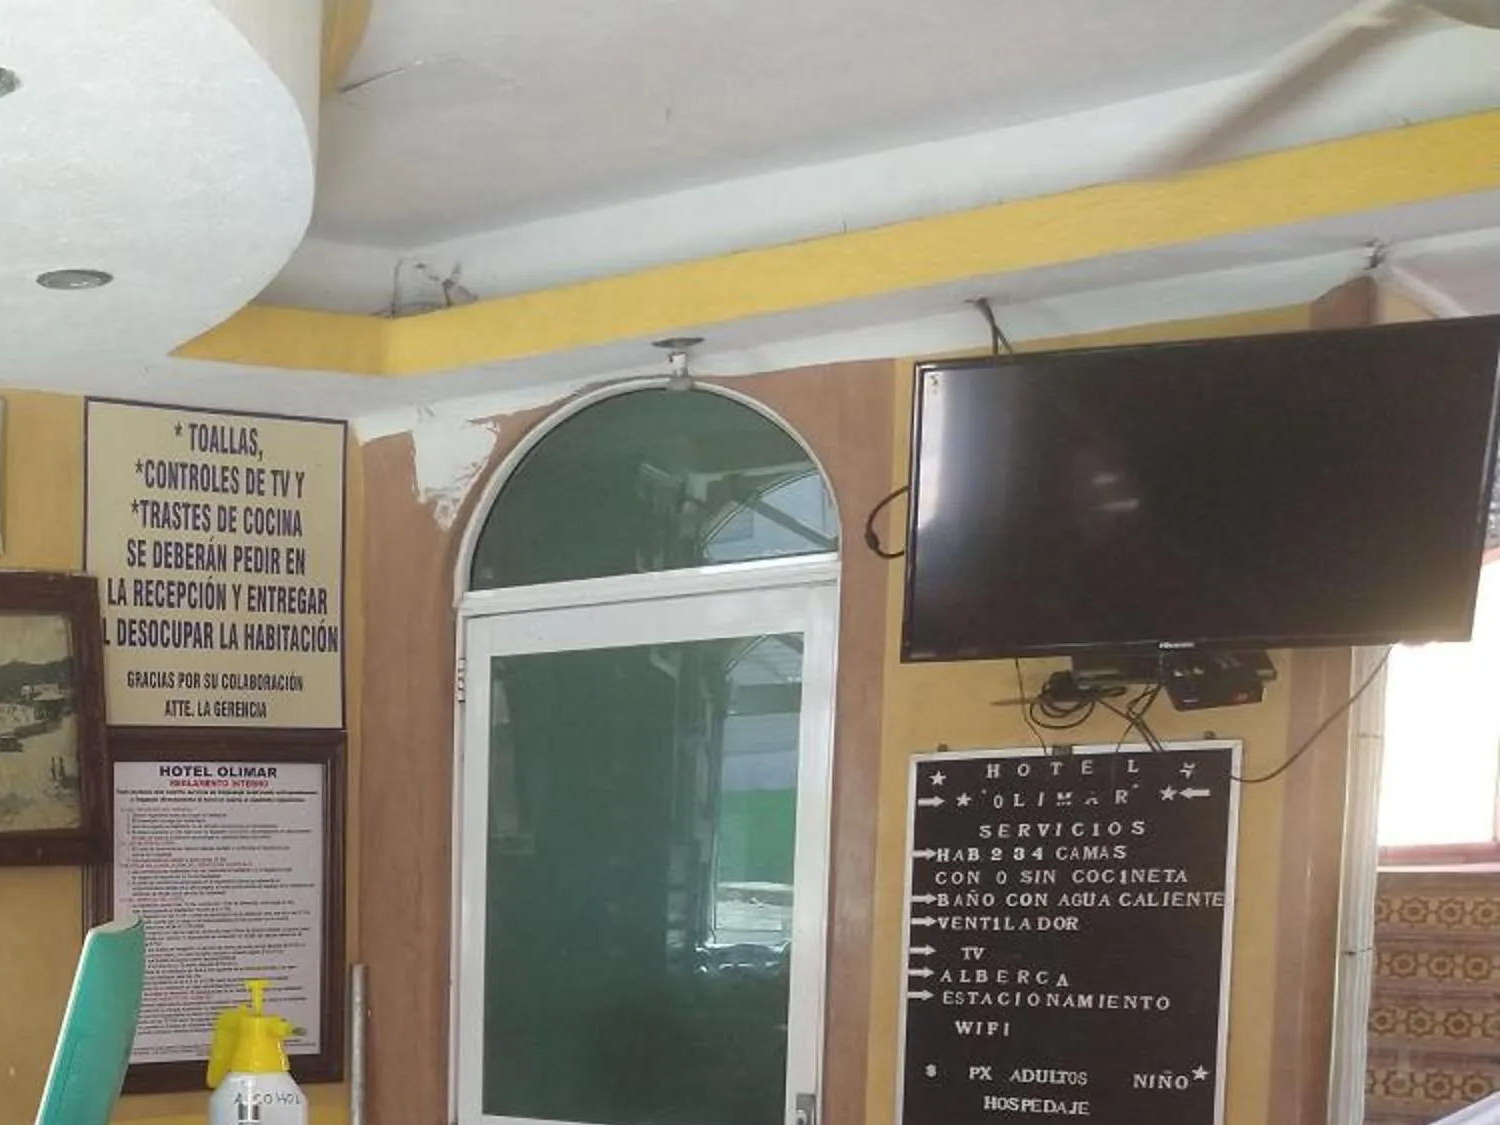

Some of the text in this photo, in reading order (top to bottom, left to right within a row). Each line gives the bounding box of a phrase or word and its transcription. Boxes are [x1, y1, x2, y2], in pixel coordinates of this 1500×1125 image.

[189, 423, 263, 460] TOALLAS,
[145, 460, 305, 499] CONTROLES DE TV Y
[140, 500, 303, 537] TRASTES DE COCINA
[127, 536, 306, 575] SE DEBERÁN PEDIR EN
[107, 576, 328, 615] LA RECEPCIÓN Y ENTREGAR
[117, 618, 339, 653] DESOCUPAR LA HABITACIÓN
[127, 670, 303, 692] GRACIAS POR SU COLABORACIÓN
[197, 700, 267, 719] LA GERENCIA
[159, 765, 277, 779] HOTEL OLIMAR
[986, 759, 1140, 780] HOTEL
[979, 821, 1146, 839] SERVICIOS
[936, 847, 980, 863] HAB
[1055, 846, 1127, 861] CAMAS
[936, 869, 1188, 885] CON SIN COCINETA
[937, 890, 1225, 908] BAÑO CON AGUA CALIENTE
[937, 916, 1079, 931] VENTILADOR
[961, 947, 985, 961] TV
[940, 969, 1070, 987] ALBERCA
[943, 991, 1171, 1011] ESTACIONAMIENTO
[955, 1020, 1010, 1037] WIFI
[969, 1066, 993, 1080] PX
[1009, 1070, 1087, 1086] ADULTOS
[983, 1096, 1091, 1116] HOSPEDAJE
